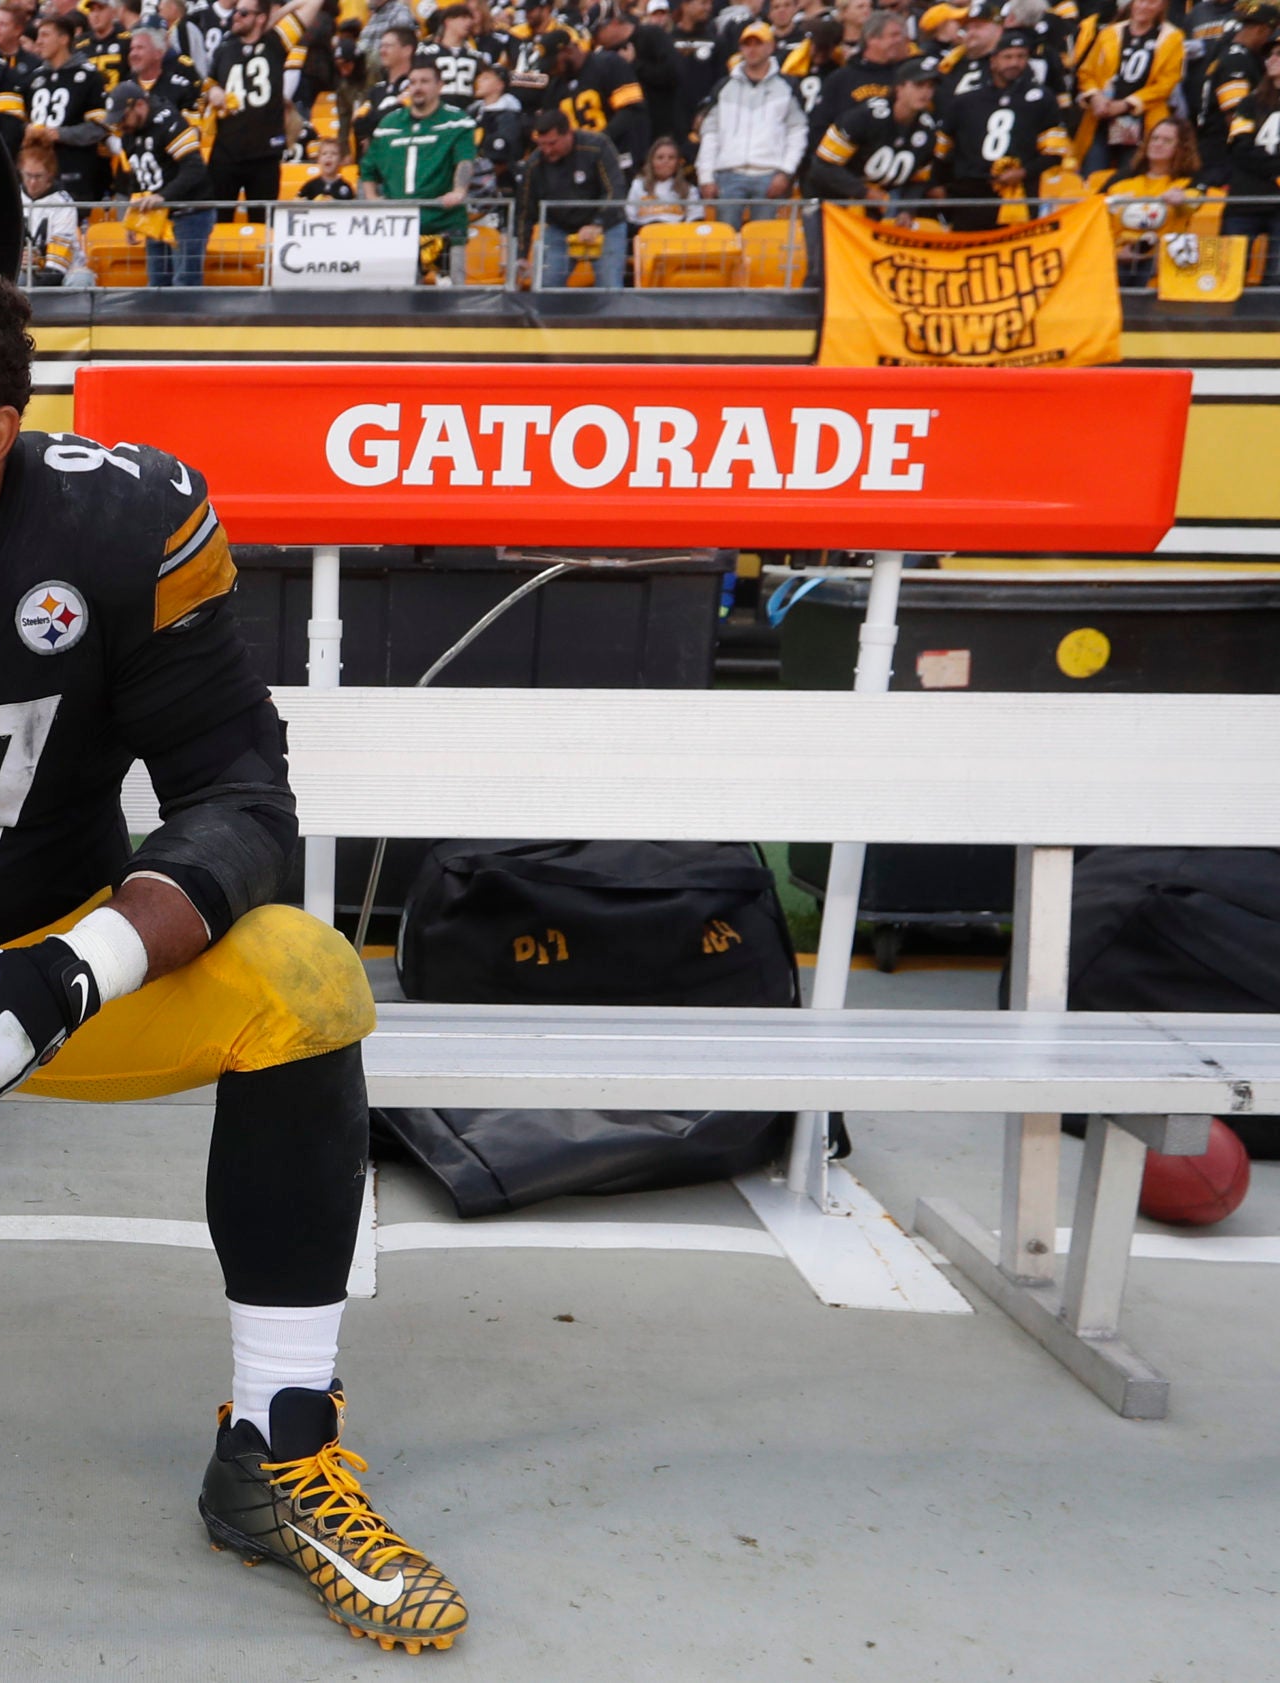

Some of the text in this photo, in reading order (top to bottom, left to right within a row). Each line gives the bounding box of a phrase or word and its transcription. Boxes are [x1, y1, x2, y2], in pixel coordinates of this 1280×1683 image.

[31, 87, 70, 127] 83
[225, 56, 271, 112] 43
[981, 108, 1015, 152] 8
[405, 145, 418, 194] 1
[864, 145, 915, 187] 90
[348, 215, 417, 237] MATT
[872, 246, 1063, 308] terrible
[901, 290, 1040, 356] towel
[325, 403, 931, 491] GATORADE
[22, 616, 51, 627] Steelers
